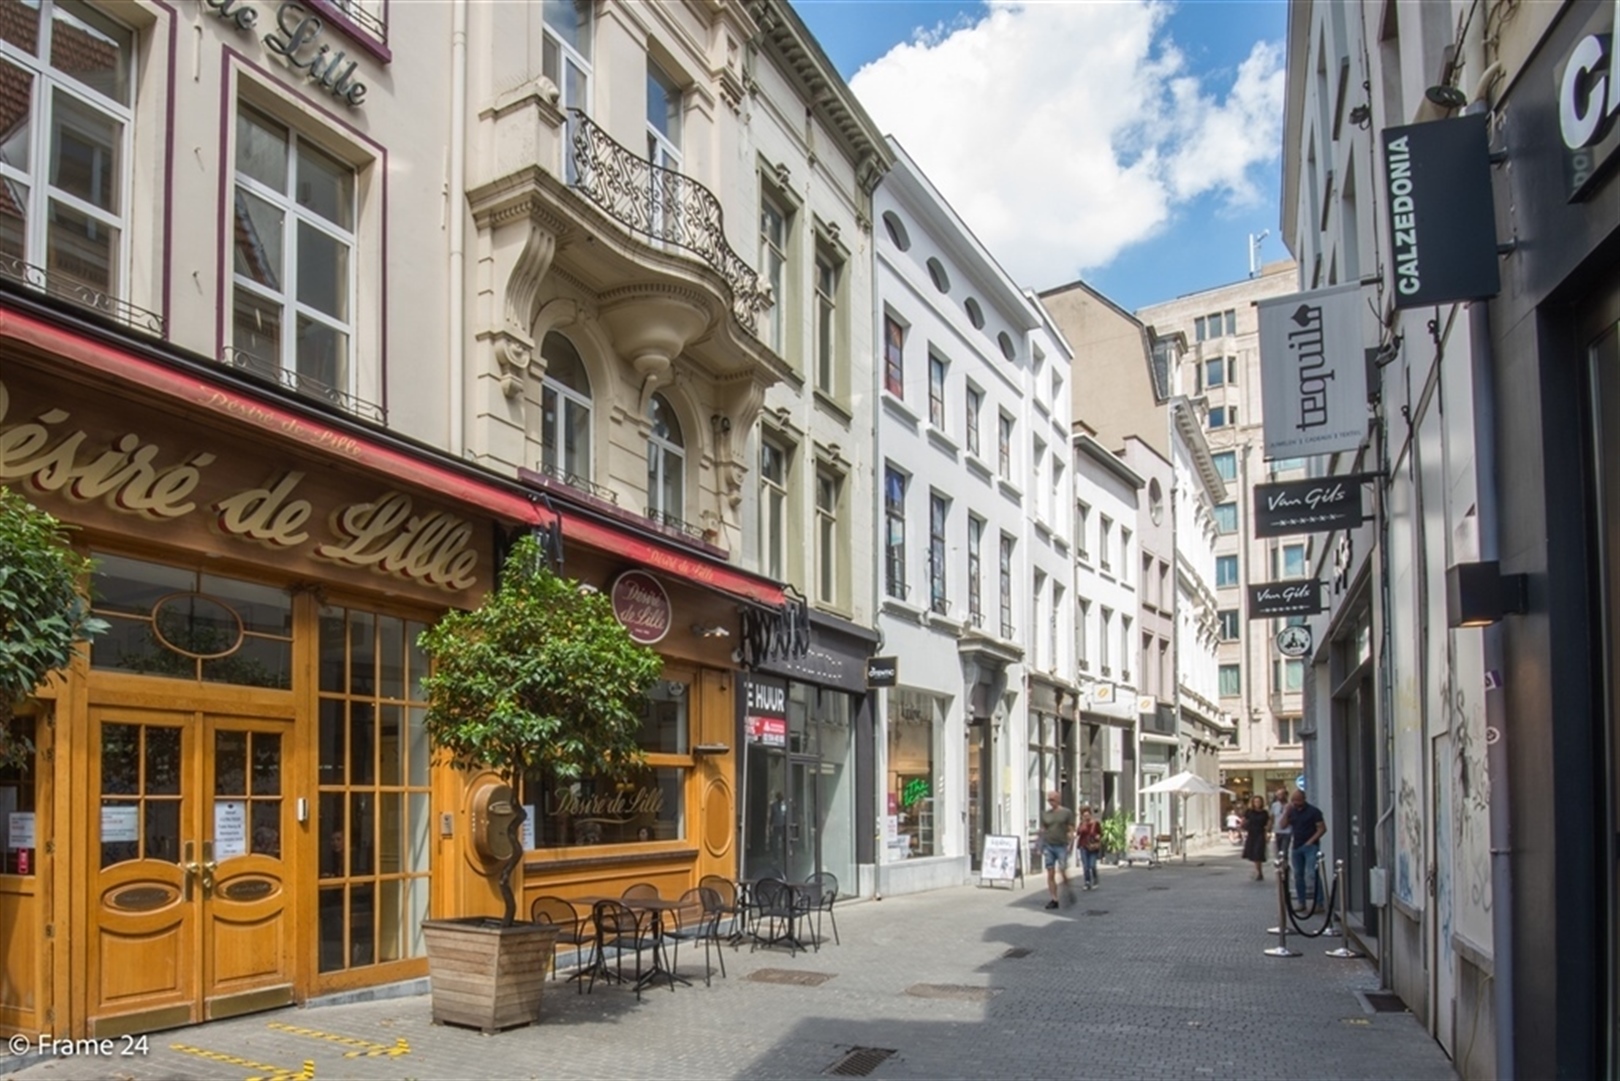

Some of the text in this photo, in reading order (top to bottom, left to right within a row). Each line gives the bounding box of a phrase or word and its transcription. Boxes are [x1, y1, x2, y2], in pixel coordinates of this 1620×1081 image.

[263, 2, 367, 106] Lille
[1559, 0, 1620, 149] C
[1388, 134, 1420, 296] CALZEDONIA
[280, 419, 306, 437] de
[311, 428, 363, 458] Lille
[0, 379, 478, 592] ésiré de Lille
[1267, 483, 1346, 511] Van Gils
[1257, 583, 1311, 602] Van Gils
[755, 683, 785, 712] HUUR
